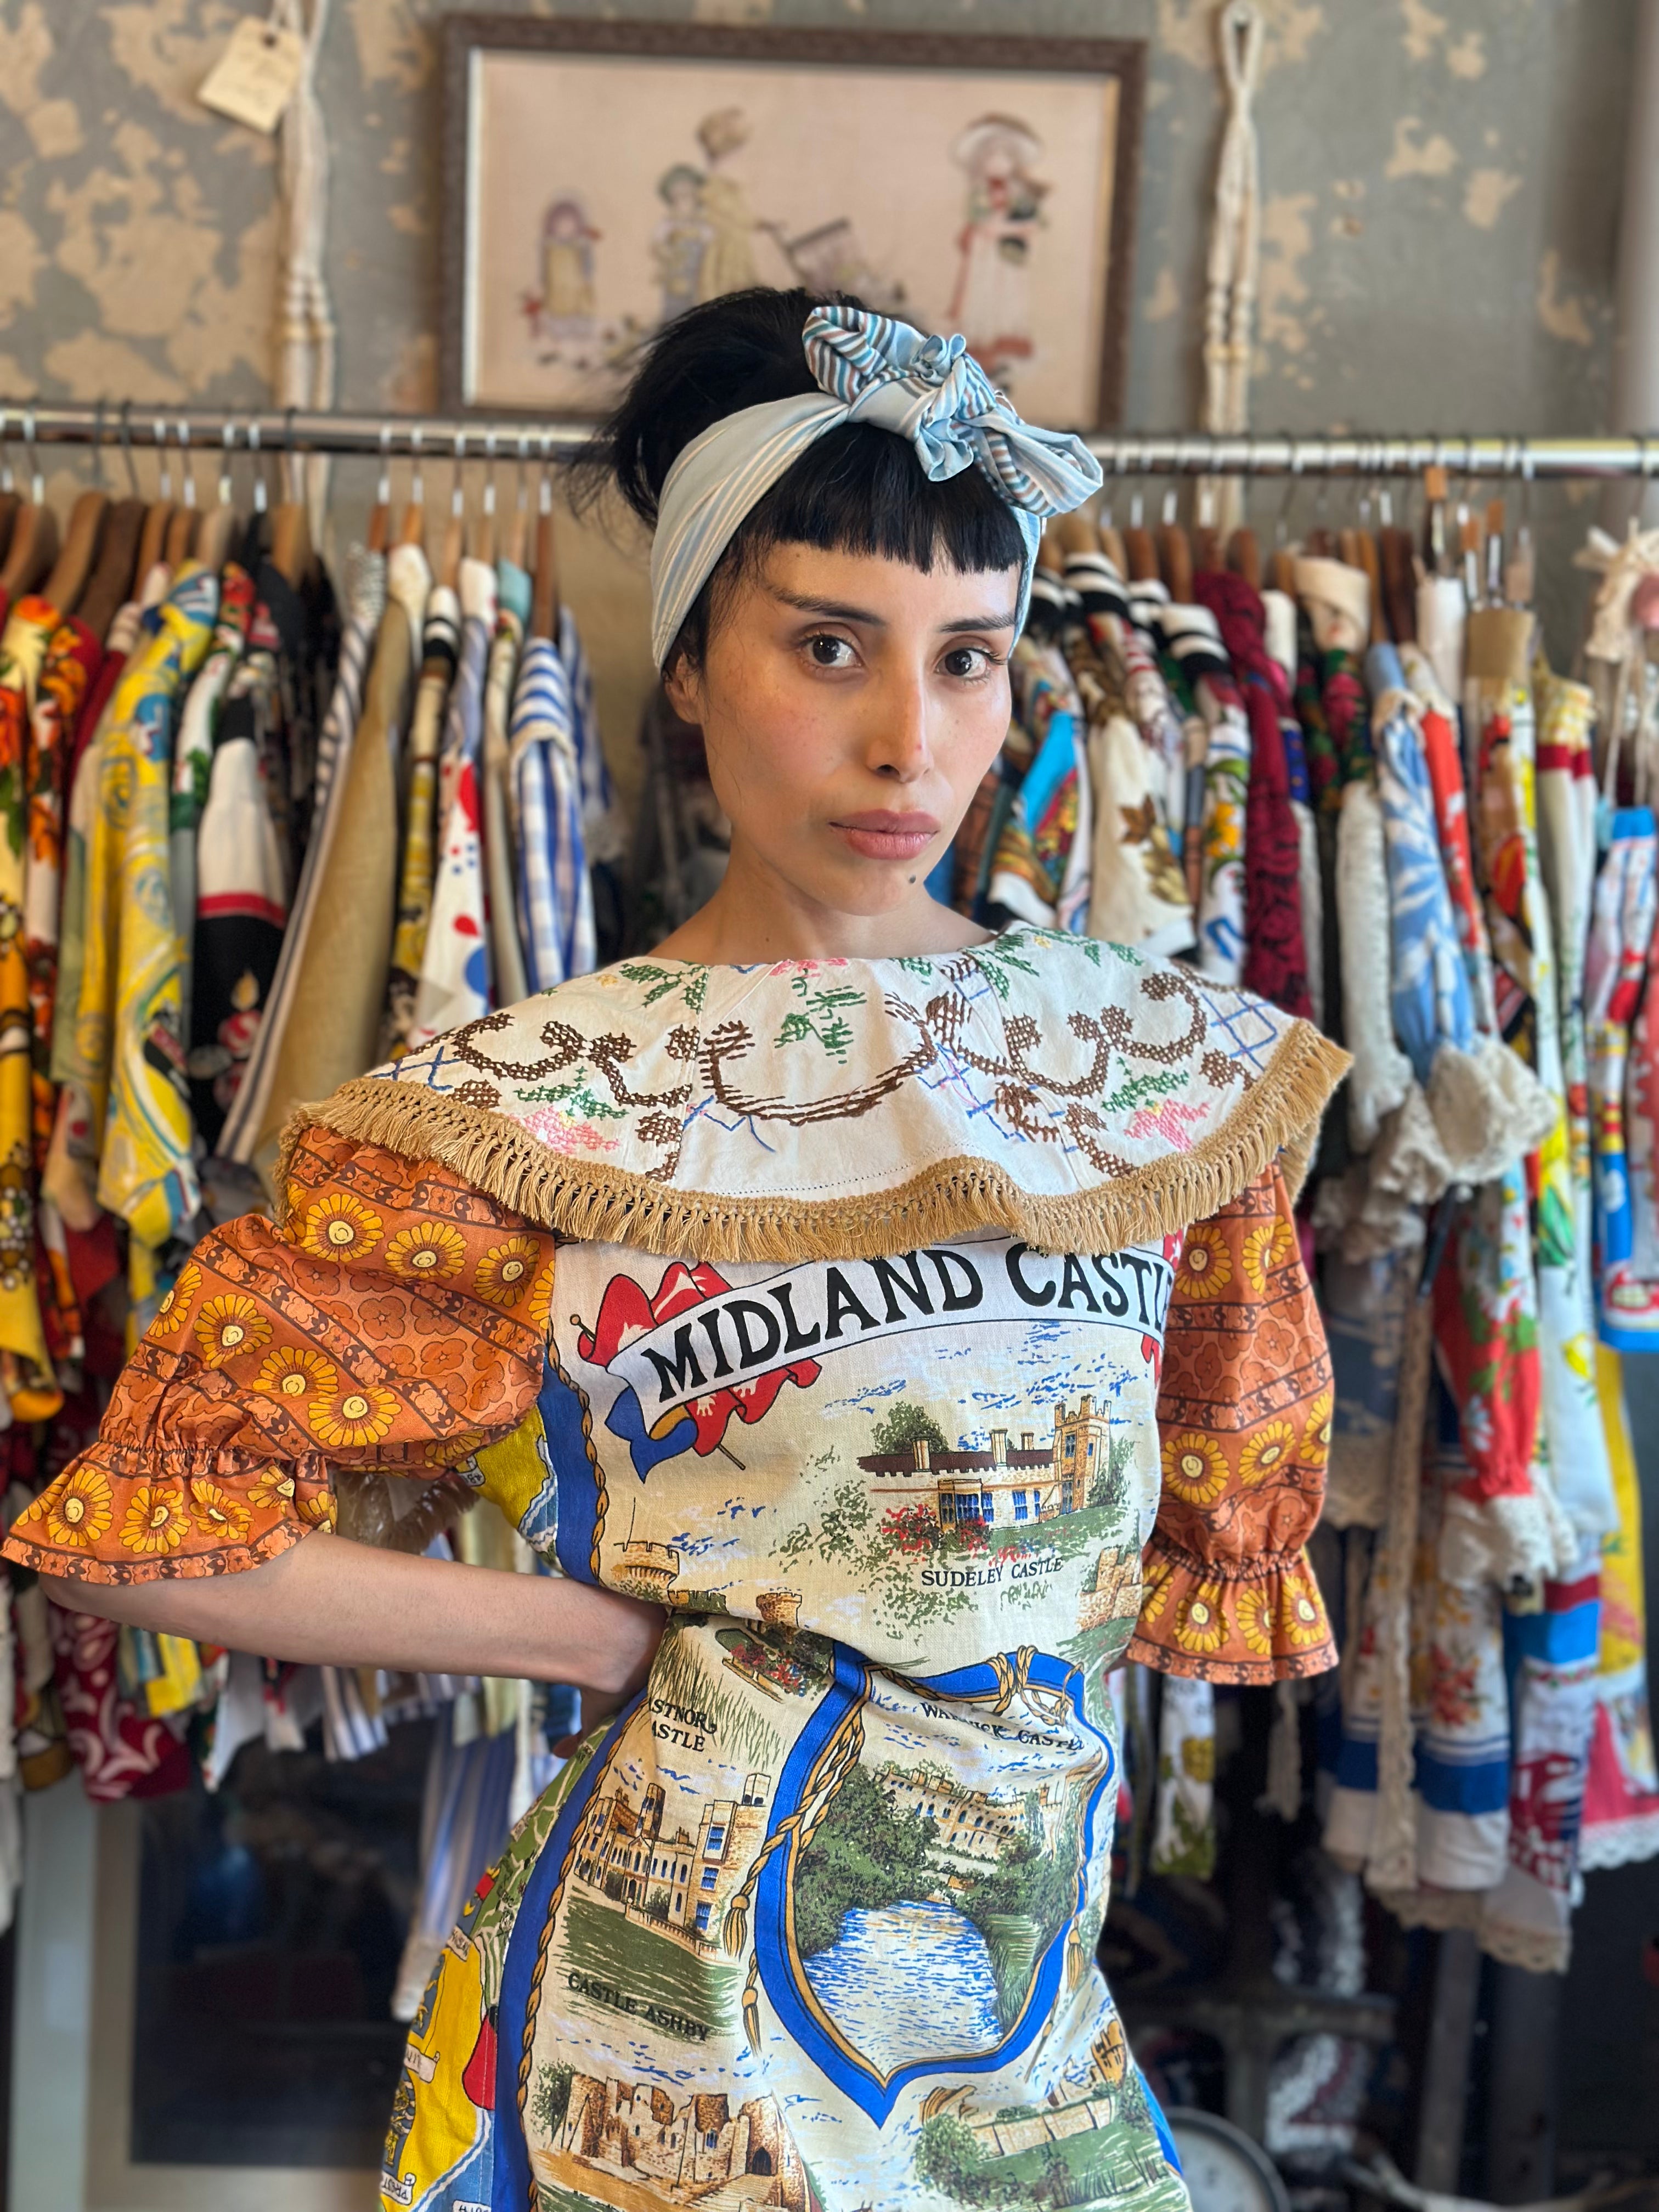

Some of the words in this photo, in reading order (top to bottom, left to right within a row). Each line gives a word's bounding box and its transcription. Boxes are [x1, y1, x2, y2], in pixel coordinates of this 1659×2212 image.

[641, 1249, 984, 1403] MIDLAND
[921, 1566, 1004, 1587] SUDELEY
[1011, 1558, 1064, 1579] CASTLE
[568, 1972, 638, 2015] CASTLE
[644, 2004, 709, 2041] ASHBY
